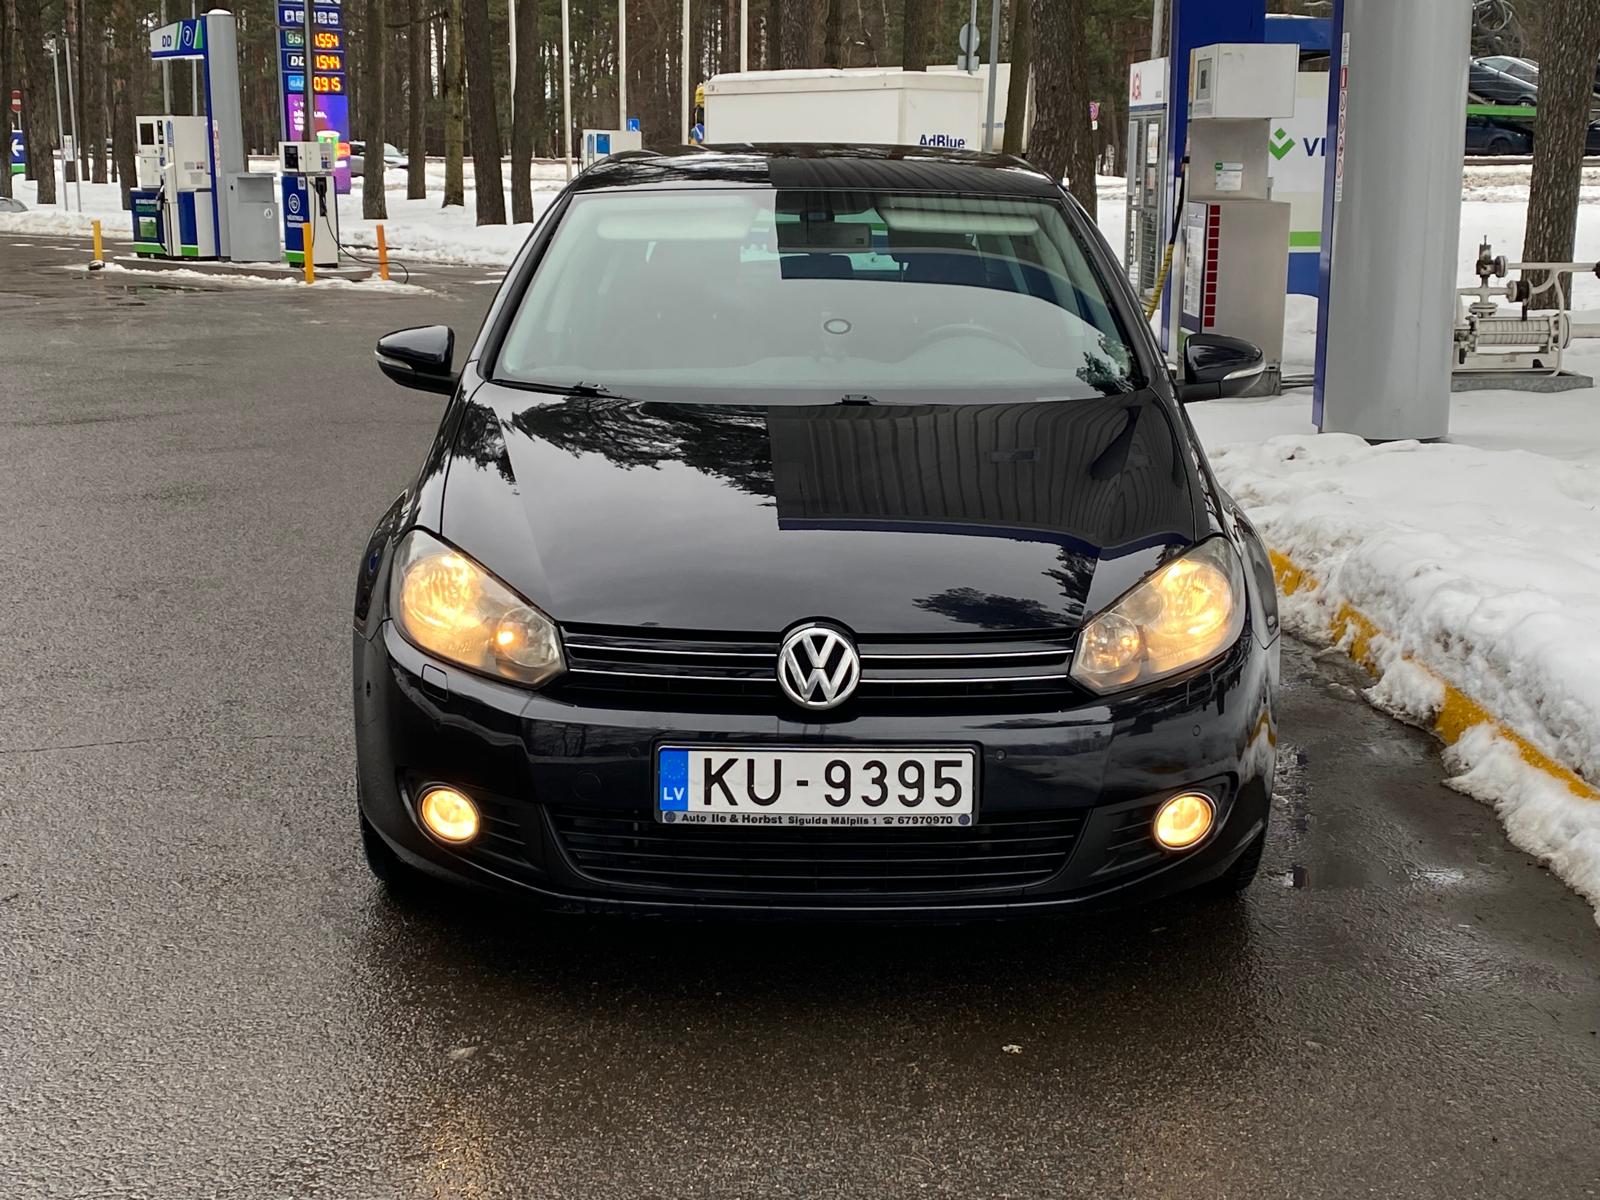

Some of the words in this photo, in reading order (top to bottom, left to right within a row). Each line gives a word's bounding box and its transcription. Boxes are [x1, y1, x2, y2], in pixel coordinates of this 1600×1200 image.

[162, 35, 172, 48] DD
[920, 134, 965, 148] AdBlue
[703, 757, 963, 808] KU-9395
[663, 787, 685, 801] LV
[681, 813, 707, 824] Auto
[711, 813, 727, 824] Ile
[729, 814, 739, 824] &
[742, 814, 783, 825] Herbst
[788, 815, 828, 827] Sigulda
[872, 817, 877, 825] 1
[897, 815, 953, 824] 67970970
